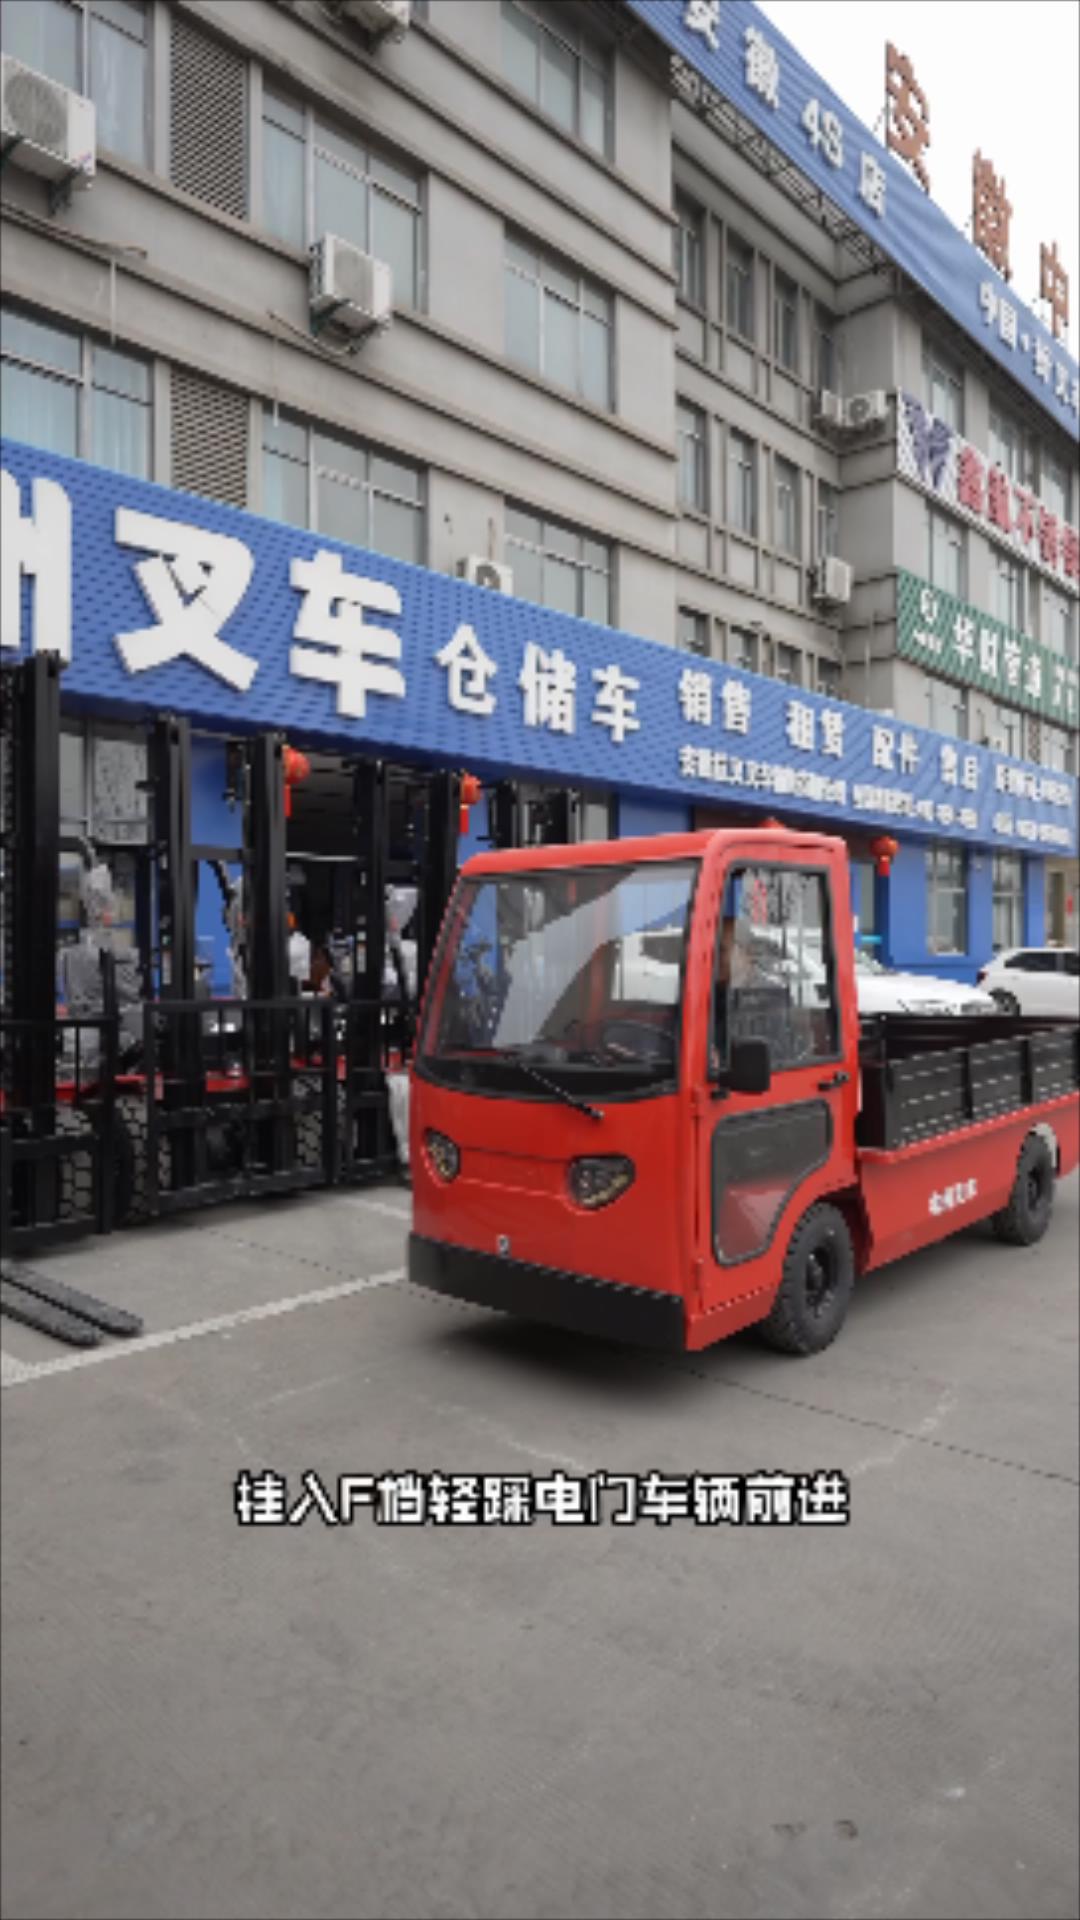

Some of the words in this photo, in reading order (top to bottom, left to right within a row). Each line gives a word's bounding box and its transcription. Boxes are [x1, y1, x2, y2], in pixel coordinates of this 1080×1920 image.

[435, 623, 643, 743] 仓储车
[678, 668, 751, 735] 销售
[787, 699, 845, 758] 租赁
